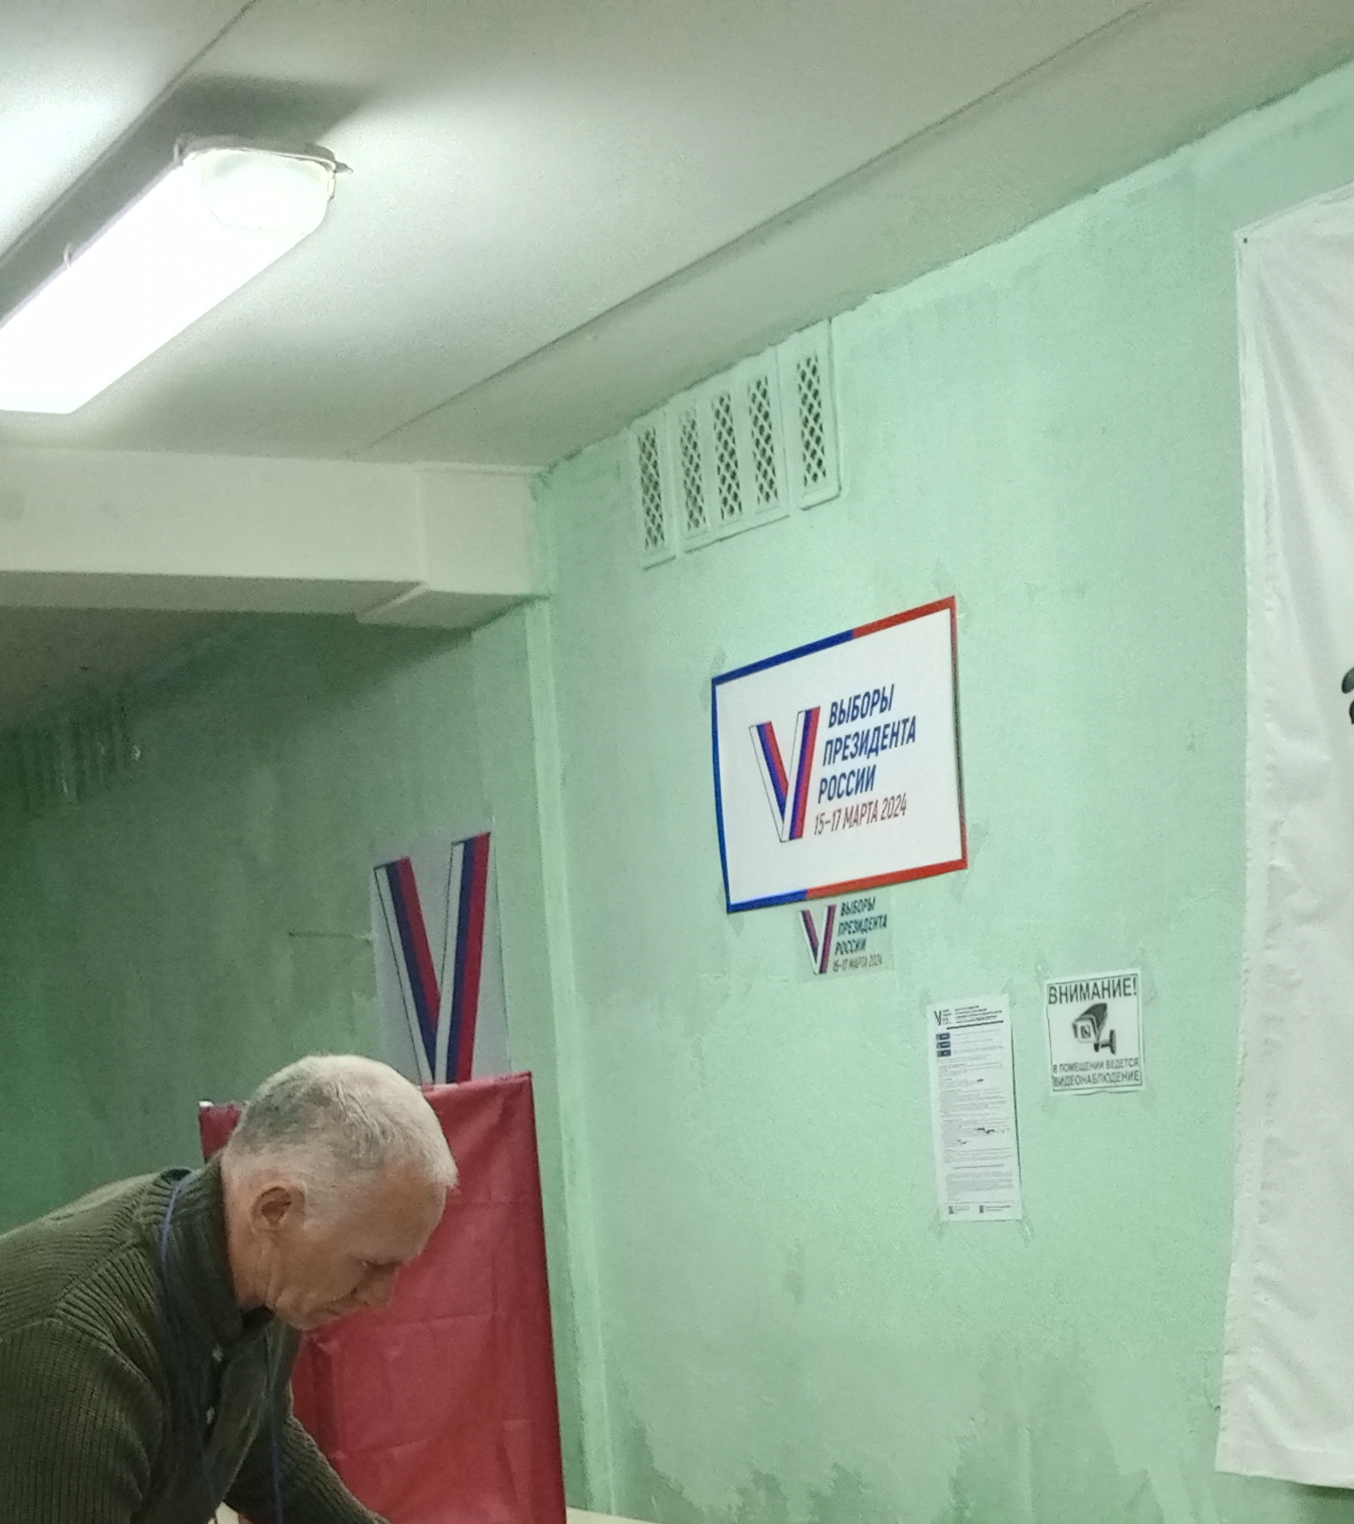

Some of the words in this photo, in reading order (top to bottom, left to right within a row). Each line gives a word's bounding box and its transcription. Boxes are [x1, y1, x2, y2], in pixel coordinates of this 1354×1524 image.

[828, 683, 895, 728] ВЫБОРЫ
[822, 715, 917, 766] ПРЕЗИДЕНТА
[817, 764, 877, 804] РОССИИ
[843, 799, 878, 830] МАРТА
[880, 793, 908, 821] 2024
[1048, 977, 1137, 1004] ВНИМАНИЕ!
